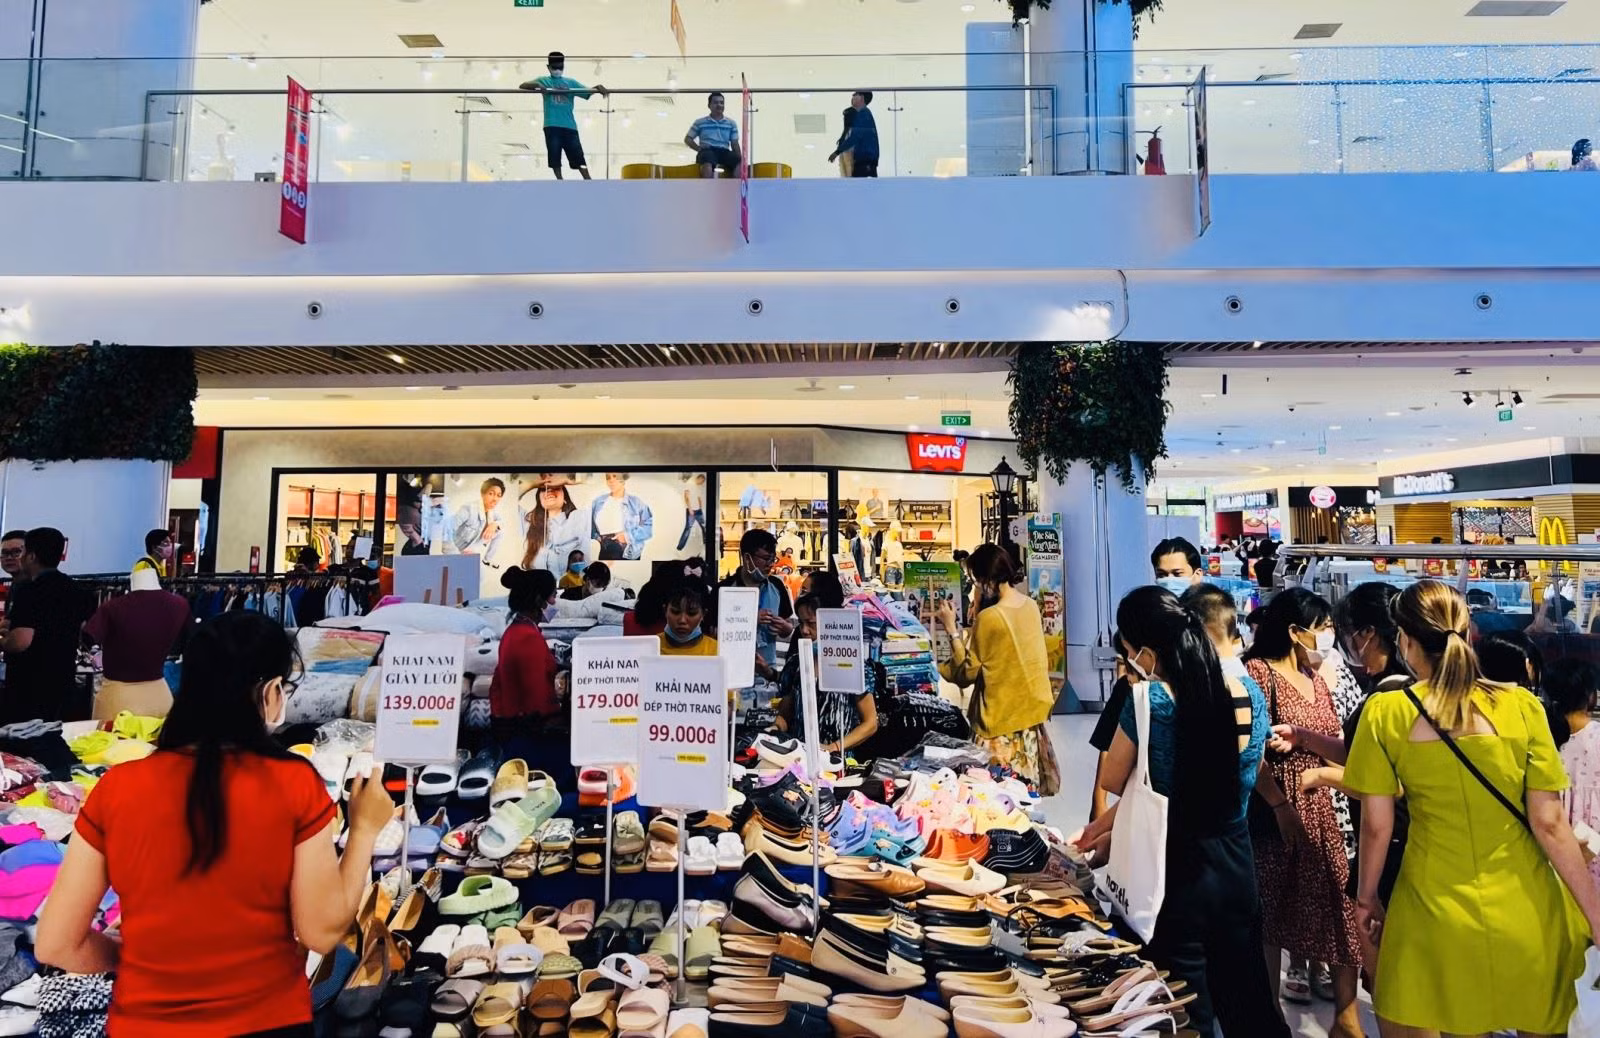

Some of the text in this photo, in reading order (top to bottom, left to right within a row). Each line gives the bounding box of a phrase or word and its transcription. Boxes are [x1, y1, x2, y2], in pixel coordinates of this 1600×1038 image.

[945, 416, 961, 425] EXIT
[839, 623, 854, 631] NAM
[823, 646, 857, 658] 99.000đ
[427, 655, 454, 666] NAM
[616, 676, 639, 685] TRAN
[655, 678, 711, 694] KHẢI NAM
[384, 695, 456, 710] 139.000đ
[690, 703, 722, 715] TRANG
[649, 724, 717, 744] 99.000đ
